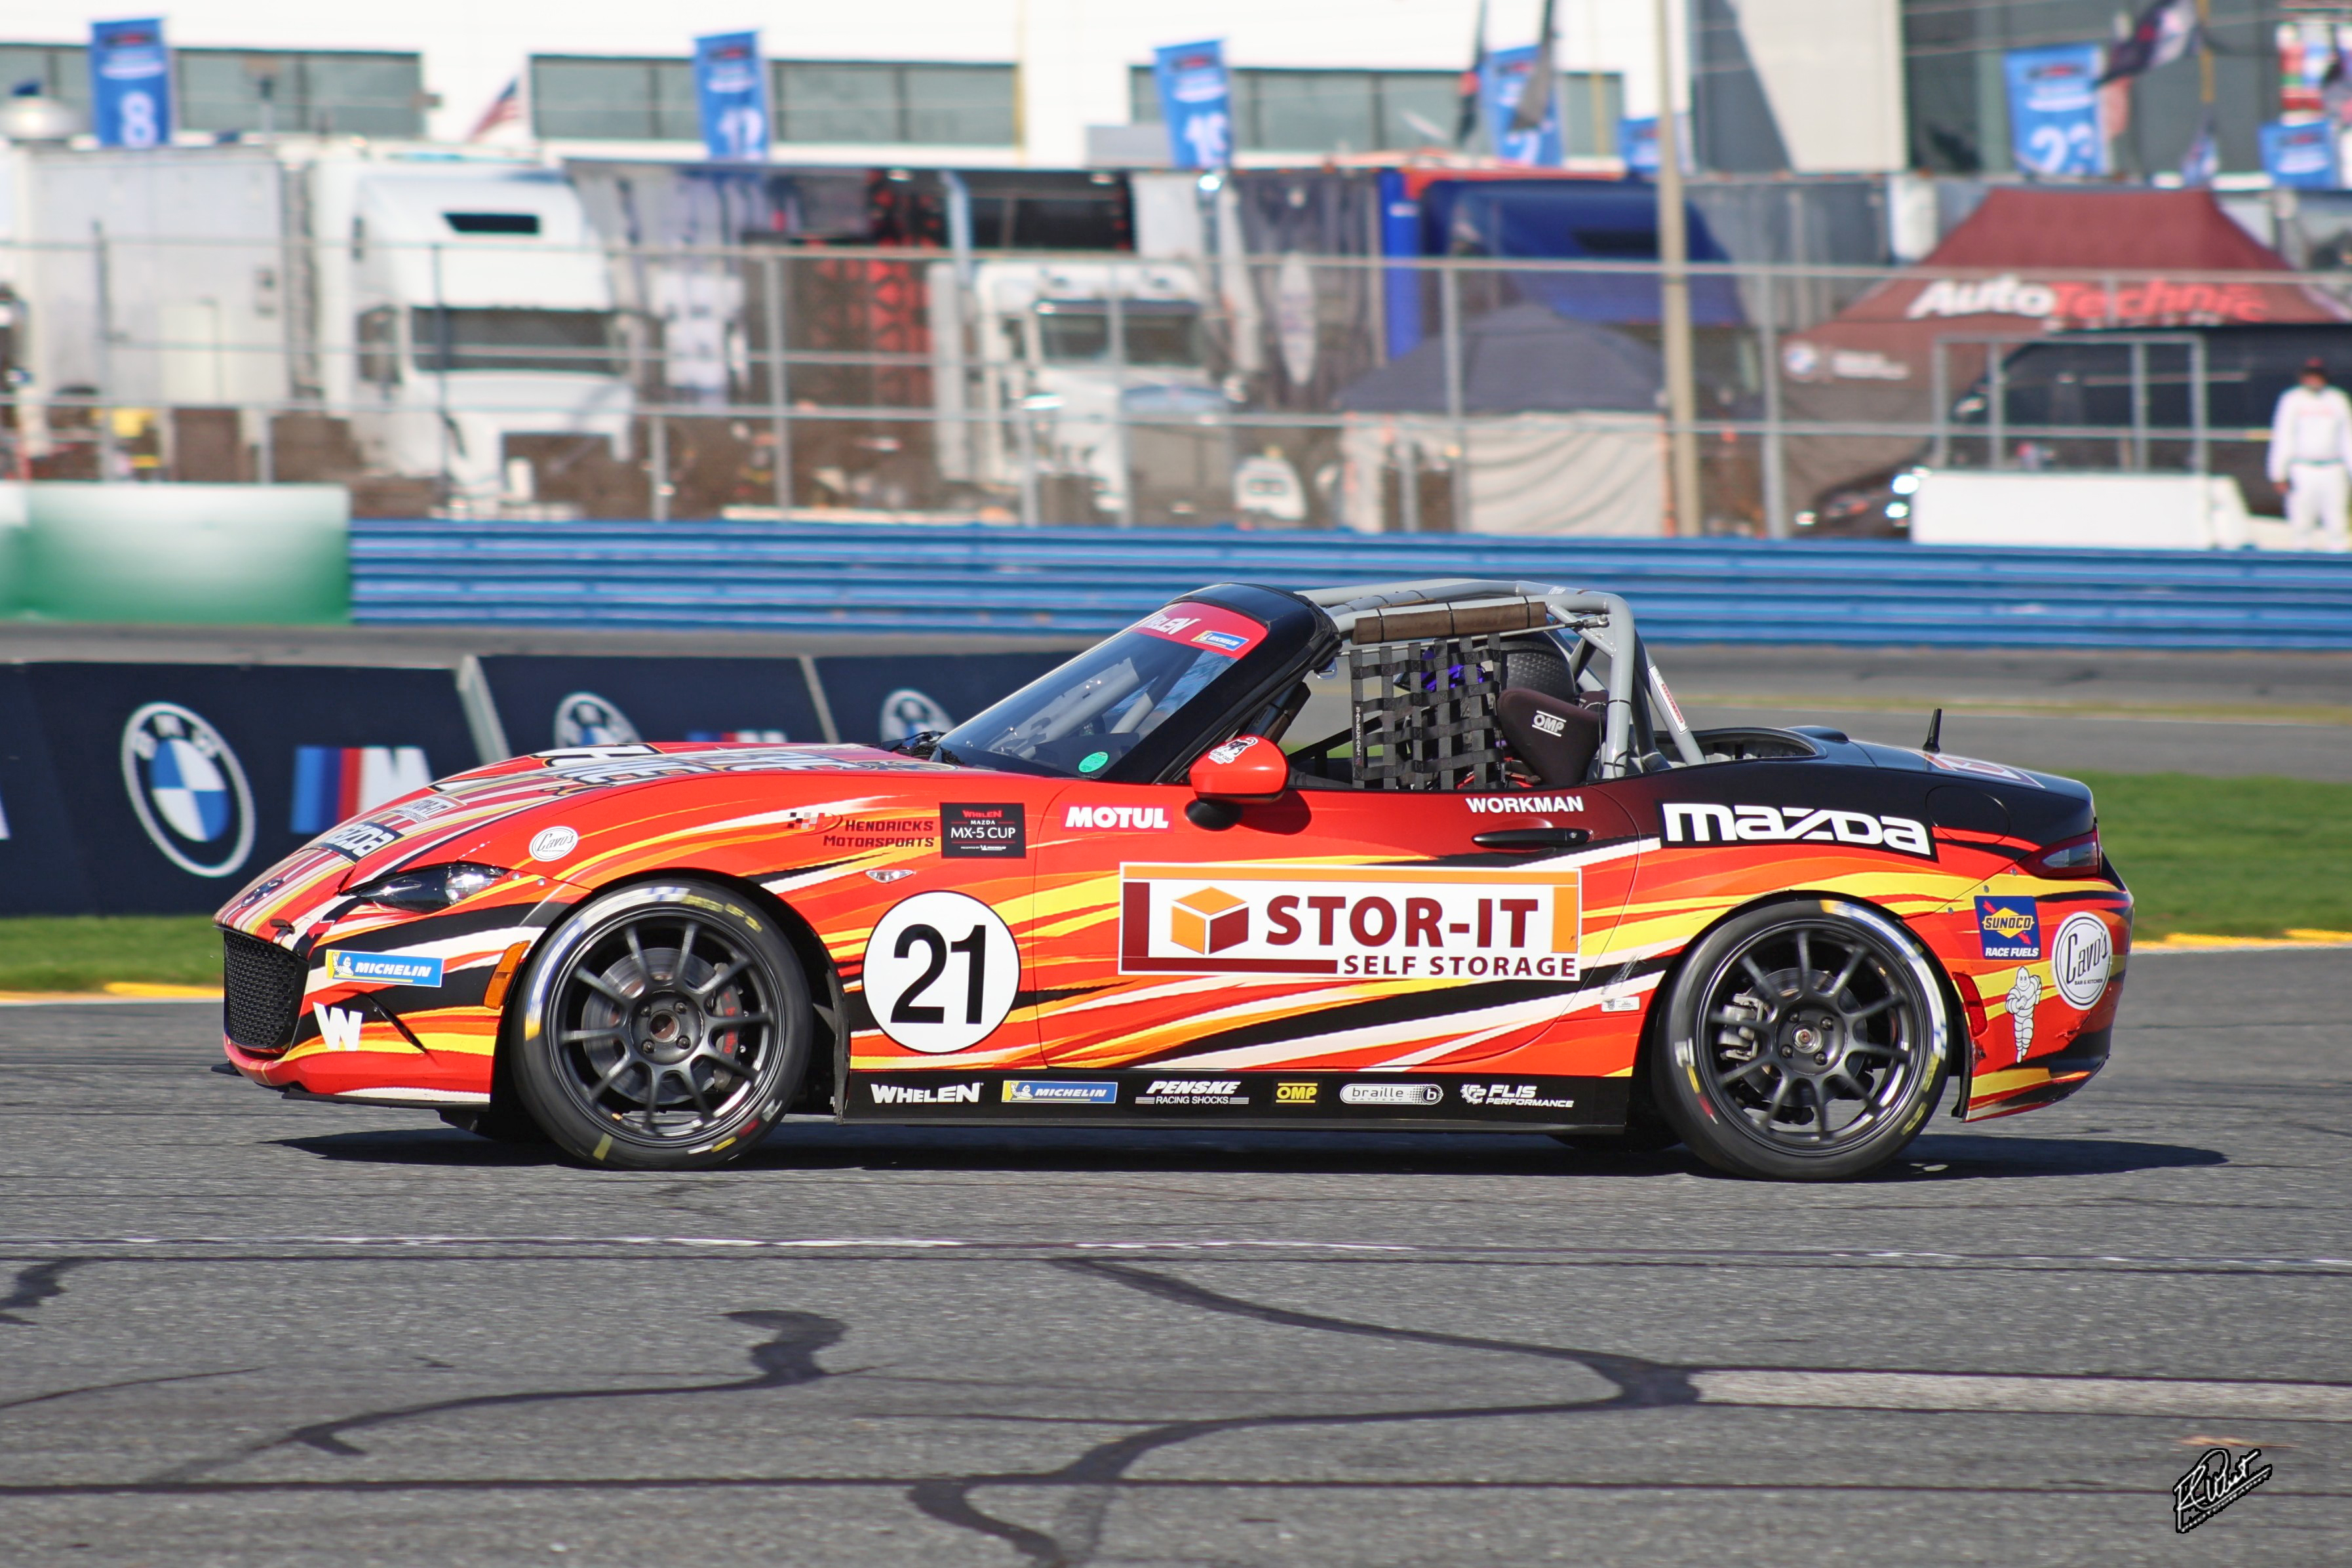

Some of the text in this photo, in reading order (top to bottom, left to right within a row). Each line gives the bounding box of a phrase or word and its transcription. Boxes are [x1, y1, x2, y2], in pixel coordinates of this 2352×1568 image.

[122, 92, 157, 147] 8
[1534, 715, 1565, 733] OMP
[1465, 796, 1584, 813] WORKMAN
[962, 810, 1003, 818] WHELEN
[1065, 806, 1169, 829] MOTUL
[845, 820, 933, 832] HENDRICKS
[951, 827, 1016, 838] MX-5 CUP
[537, 833, 574, 852] Cavo's
[823, 835, 934, 848] MOTORSPORTS
[1265, 895, 1539, 948] STOR-IT
[1985, 917, 2031, 929] SUNOCO
[1985, 947, 2039, 957] RACE FUELS
[2066, 931, 2109, 985] Cavo's
[355, 962, 432, 977] MICHELIN
[1343, 954, 1576, 977] SELF STORAGE
[890, 924, 986, 1025] 21
[313, 1002, 363, 1051] W
[871, 1082, 980, 1103] WHELEN
[1034, 1088, 1107, 1097] MICHELIN
[1146, 1081, 1242, 1094] PENSKE
[1277, 1086, 1318, 1099] OMP
[1352, 1087, 1404, 1097] braille
[1488, 1084, 1537, 1098] FLIS
[1156, 1096, 1229, 1105] RACING SHOCKS
[1485, 1097, 1575, 1108] PERFORMANCE
